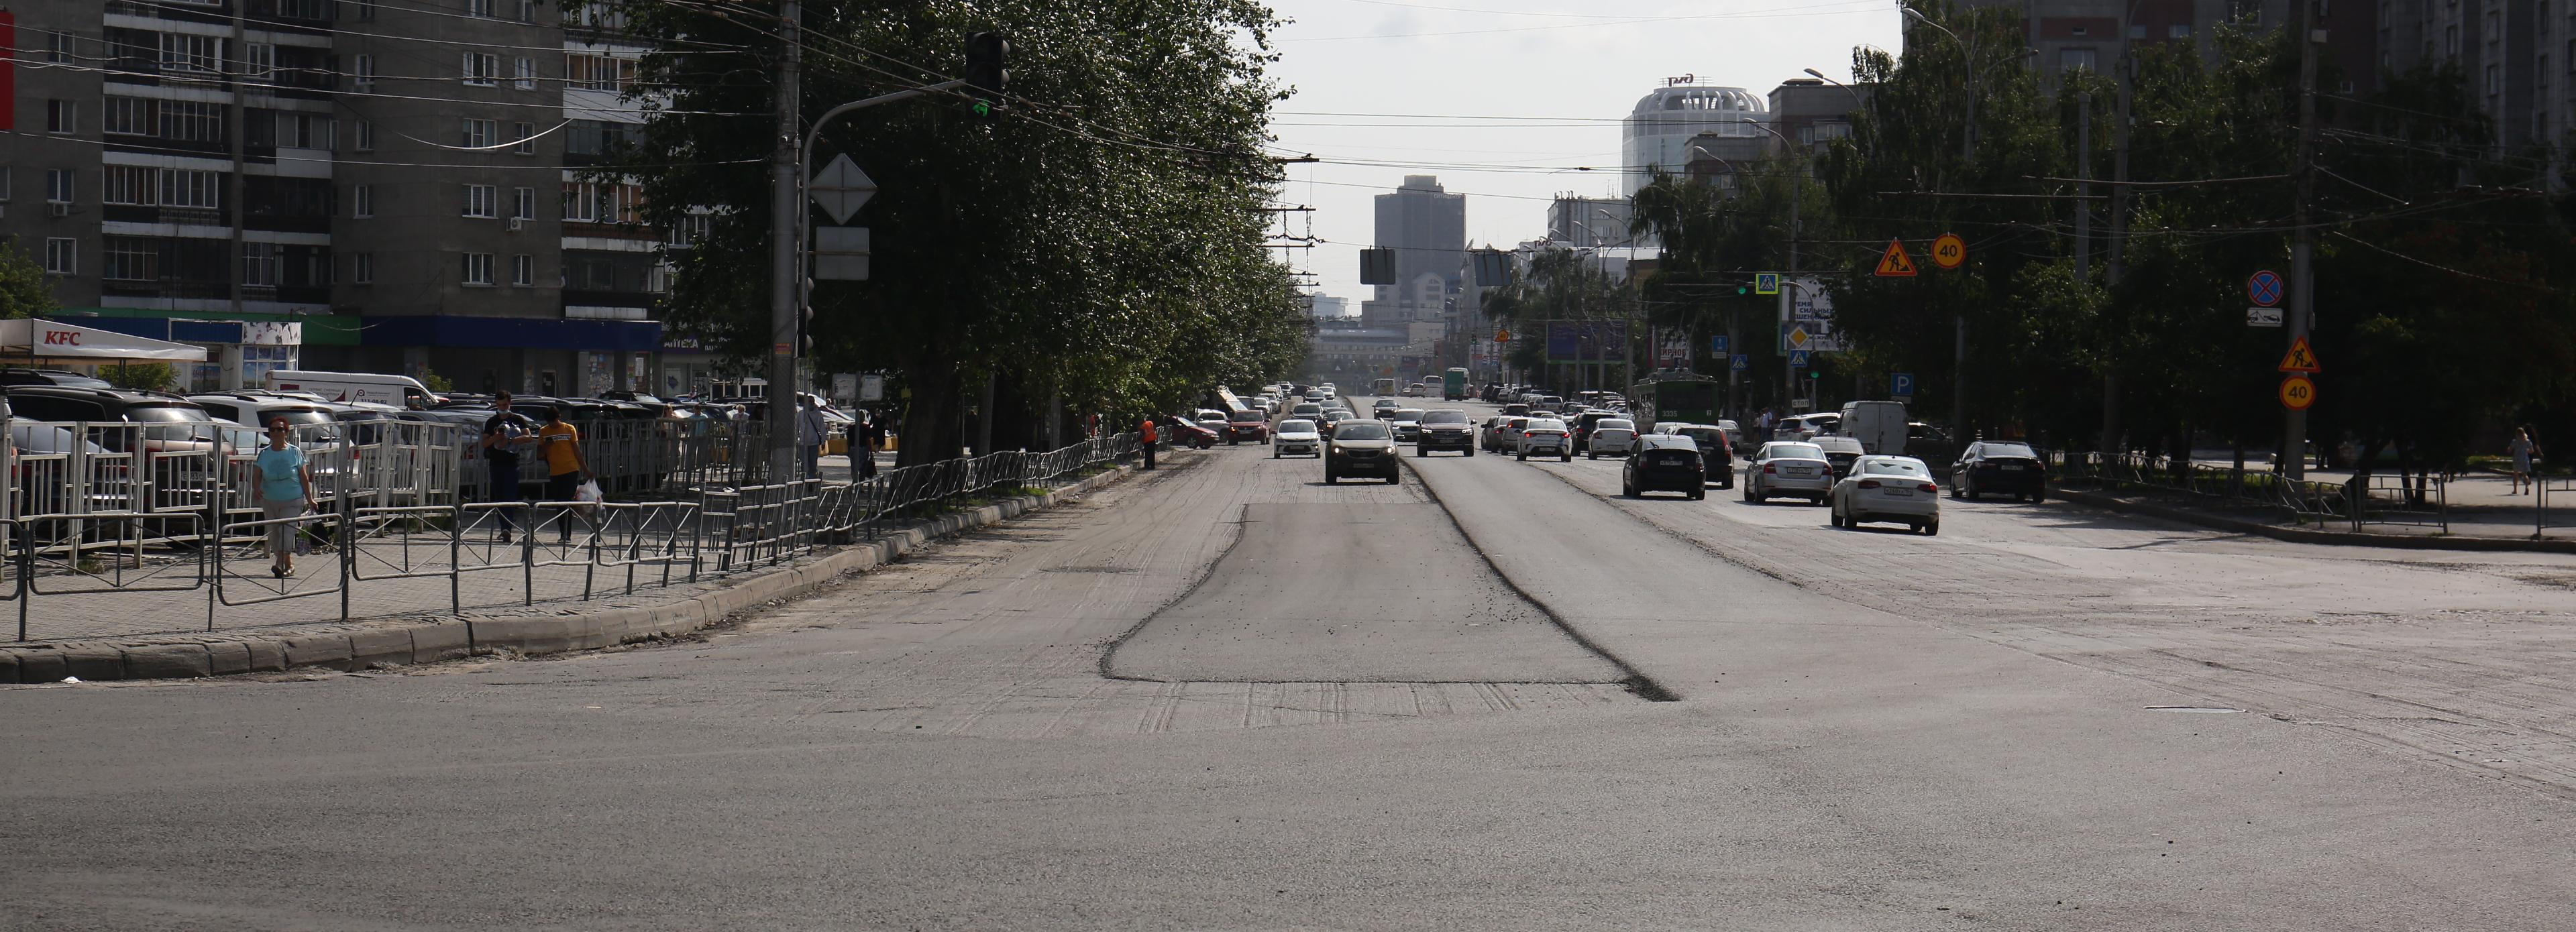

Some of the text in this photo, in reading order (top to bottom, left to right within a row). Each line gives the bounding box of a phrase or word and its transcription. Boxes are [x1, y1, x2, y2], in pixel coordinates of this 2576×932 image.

[1939, 245, 1957, 257] 40
[44, 331, 80, 346] KFC
[1898, 375, 1909, 393] P
[2288, 386, 2307, 398] 40
